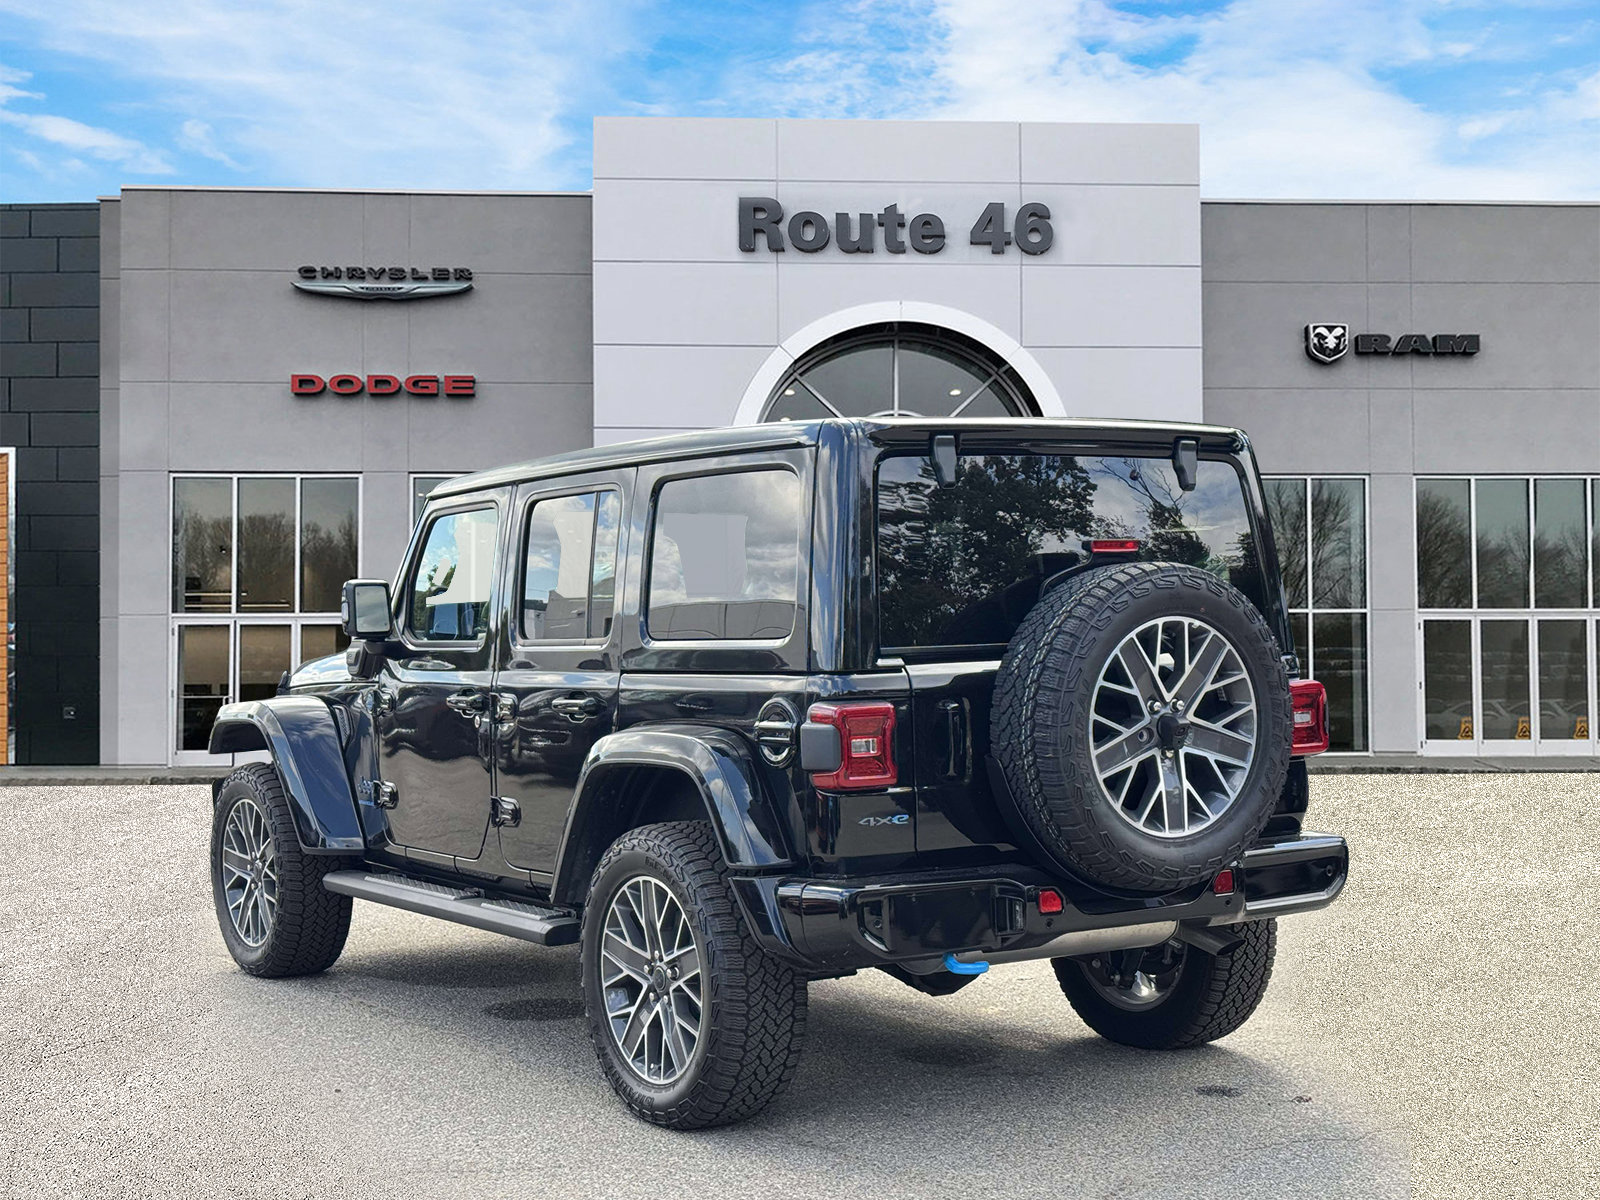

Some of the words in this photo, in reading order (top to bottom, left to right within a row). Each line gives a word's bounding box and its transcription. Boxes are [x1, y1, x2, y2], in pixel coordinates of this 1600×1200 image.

[738, 197, 946, 253] Route
[969, 202, 1054, 255] 46
[297, 266, 473, 281] CHRYSLER
[1354, 333, 1481, 356] RAM
[291, 374, 476, 397] DODGE
[858, 814, 910, 827] 4xe
